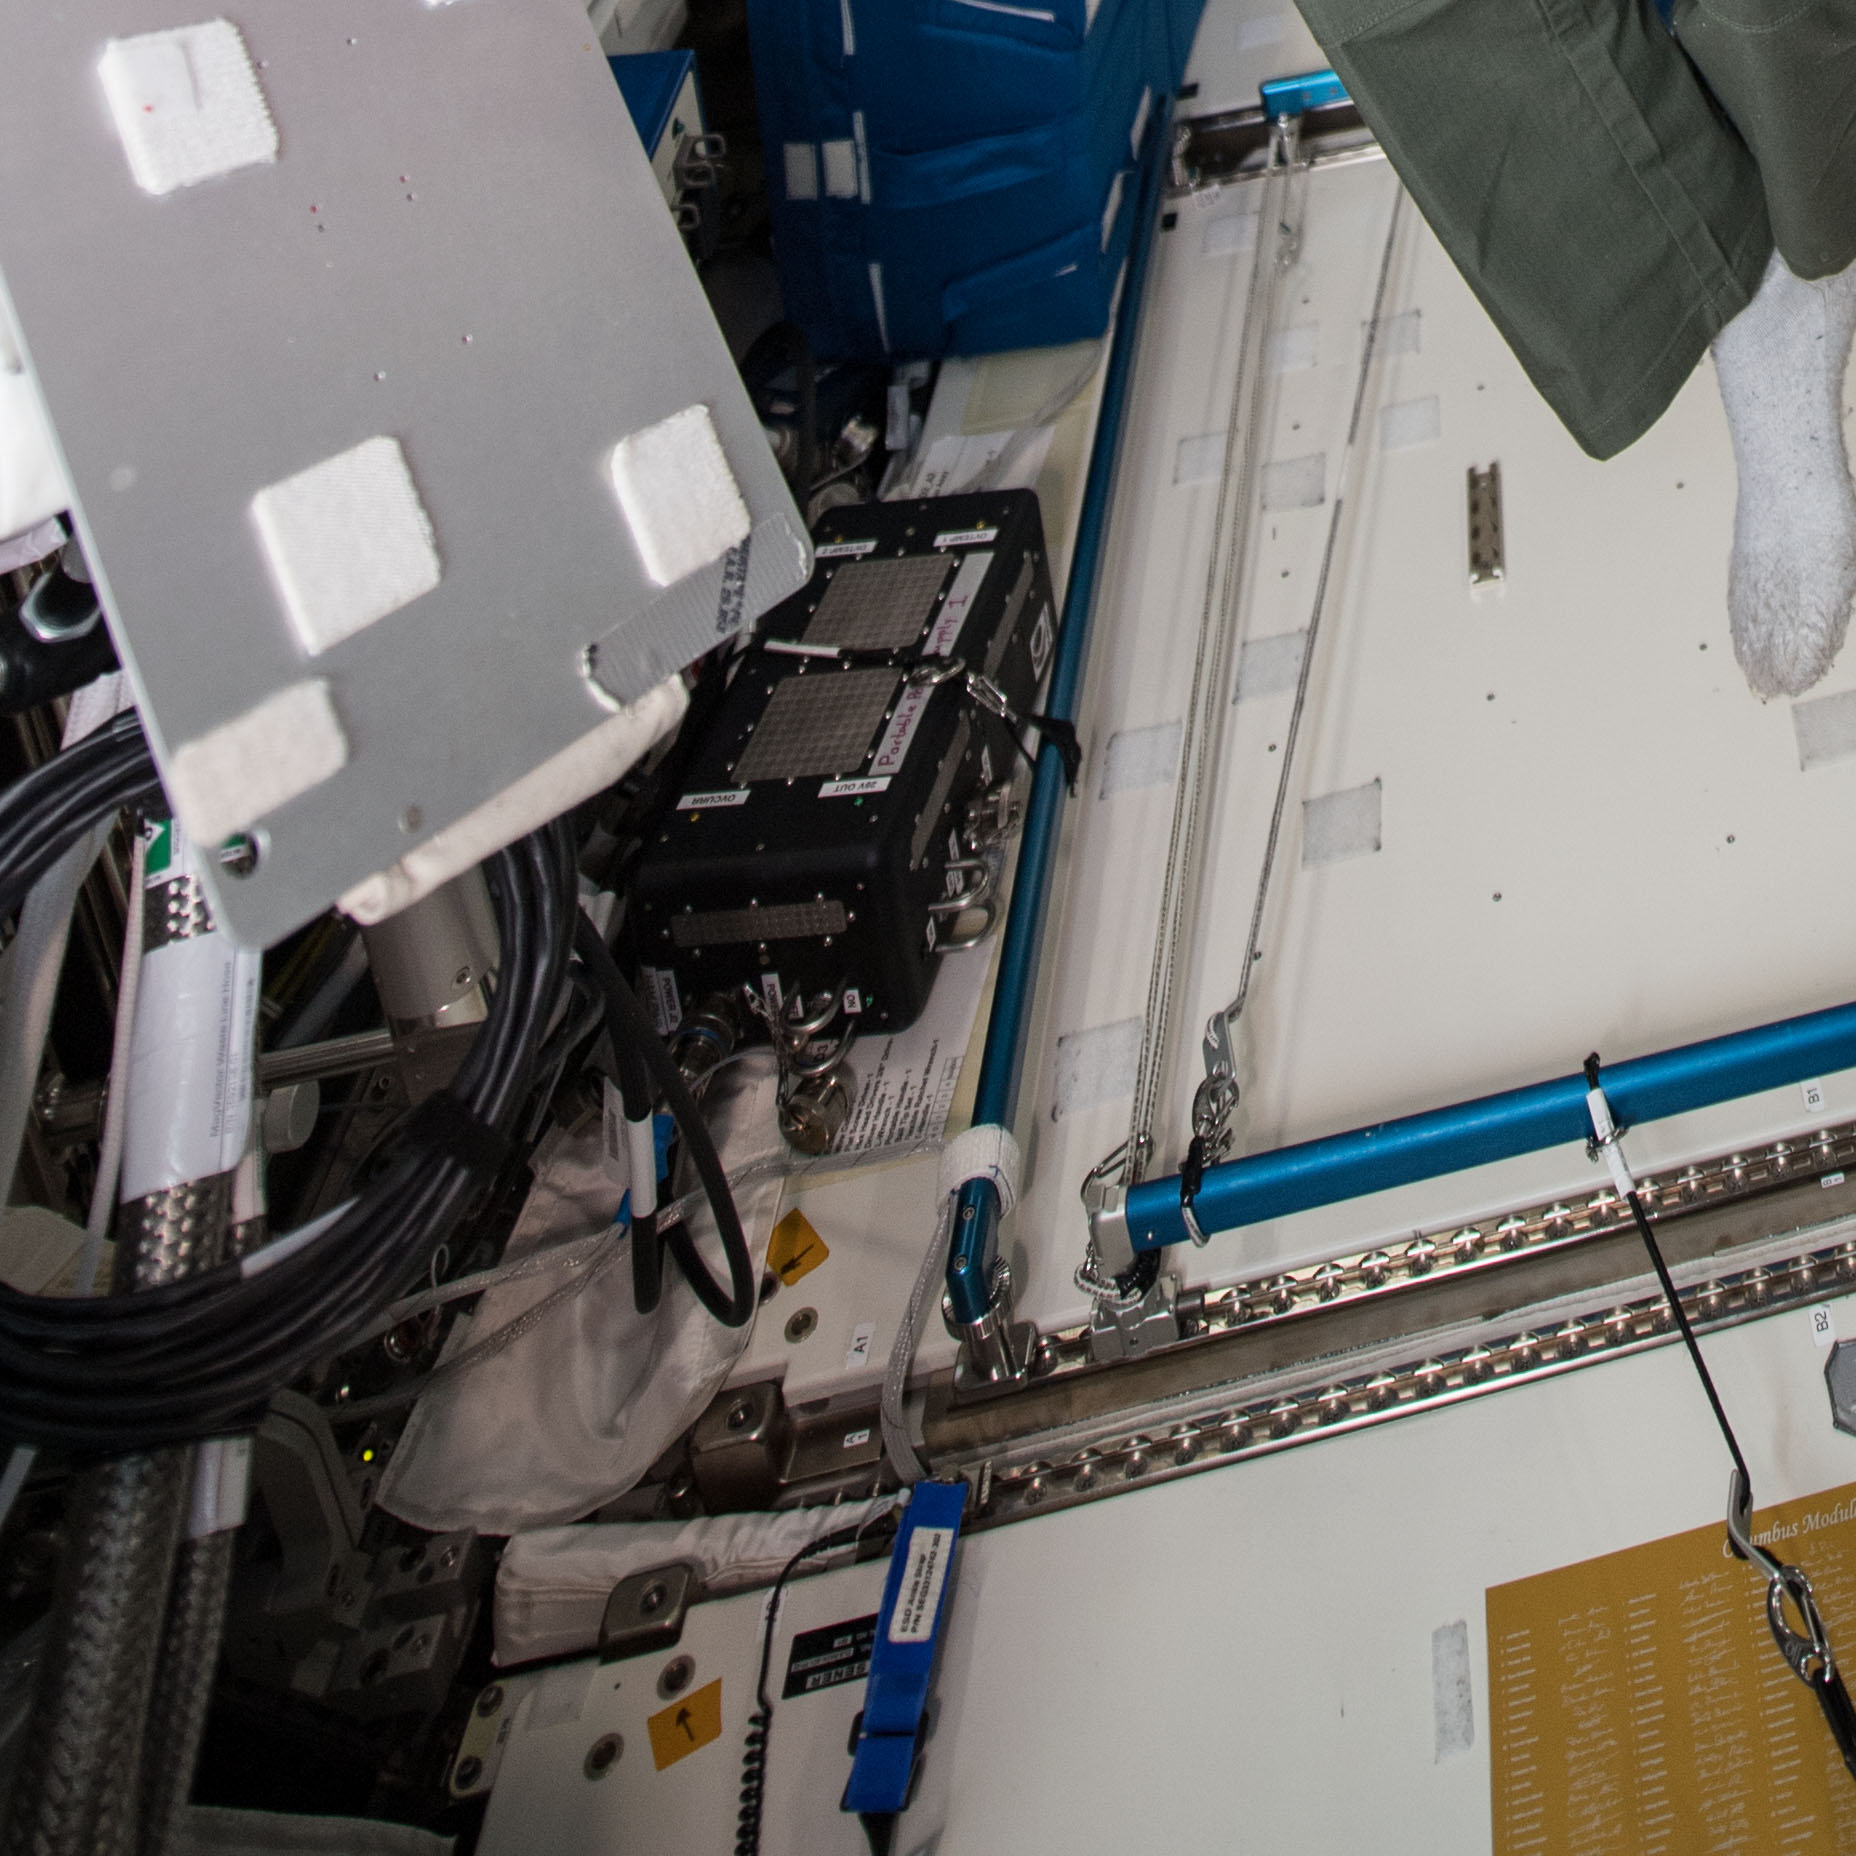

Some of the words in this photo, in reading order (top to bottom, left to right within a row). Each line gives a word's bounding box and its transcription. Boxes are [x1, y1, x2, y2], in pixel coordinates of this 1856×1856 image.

[833, 783, 855, 792] OUT
[662, 976, 678, 1010] POWER
[1806, 1085, 1821, 1105] B1
[1814, 1309, 1829, 1334] B2
[853, 1333, 868, 1354] A1
